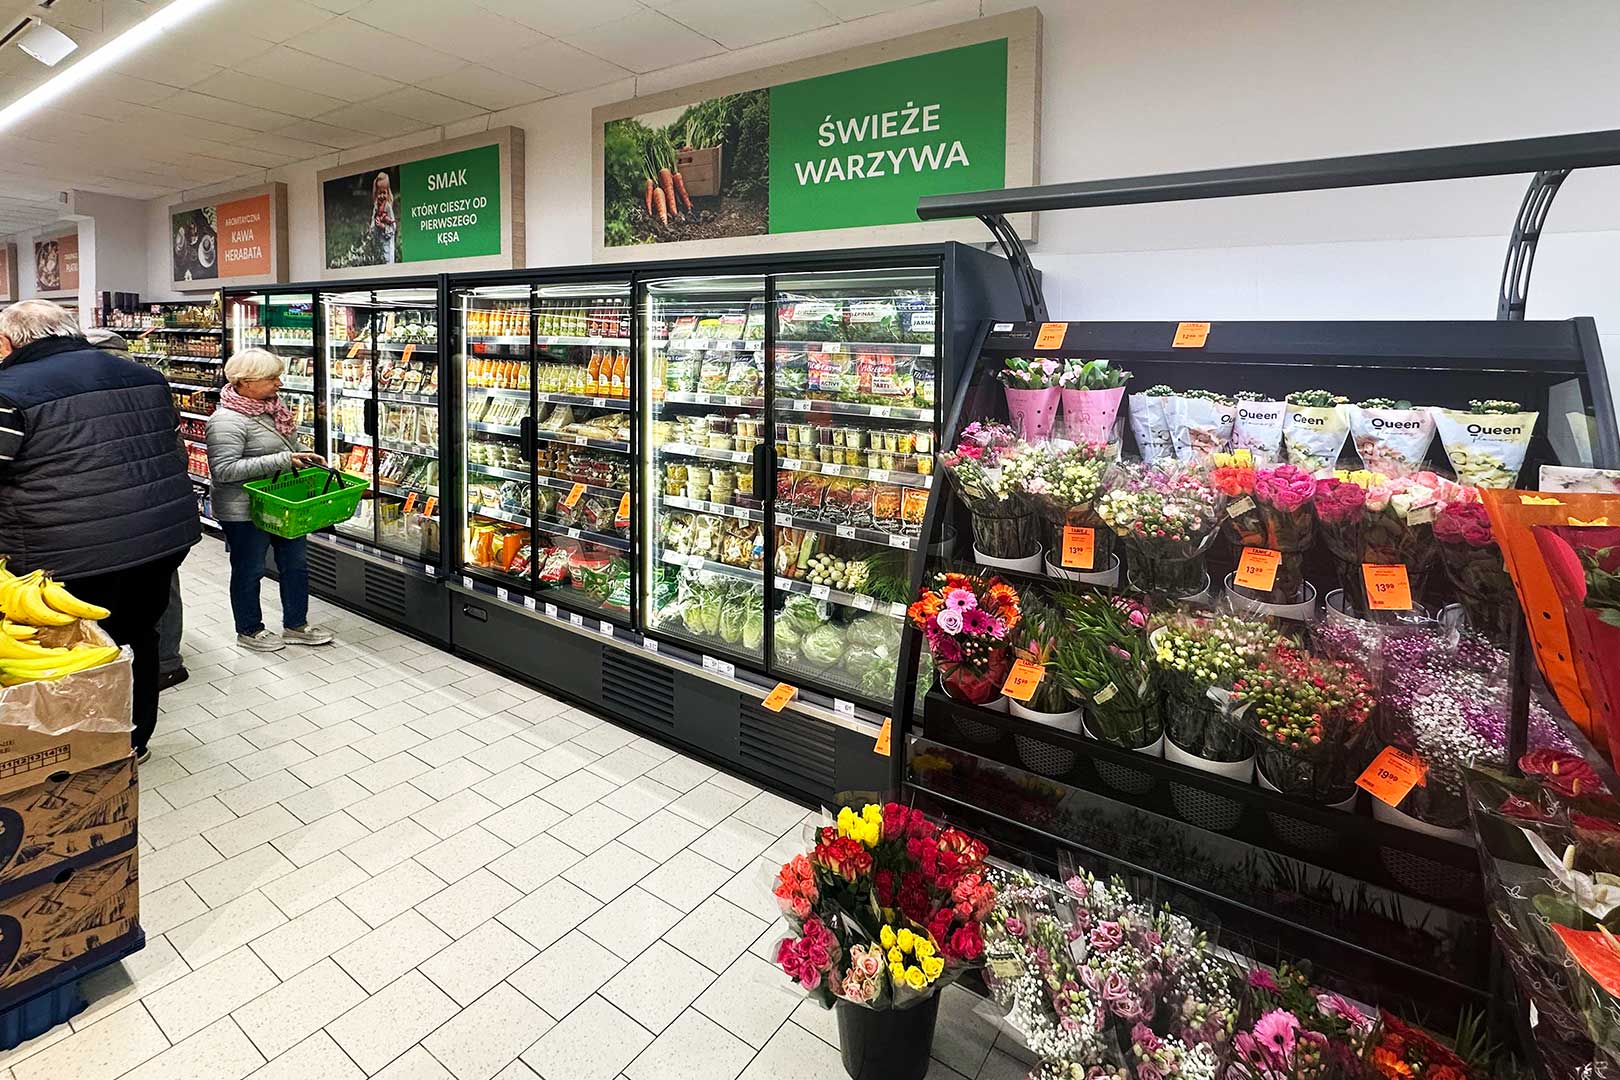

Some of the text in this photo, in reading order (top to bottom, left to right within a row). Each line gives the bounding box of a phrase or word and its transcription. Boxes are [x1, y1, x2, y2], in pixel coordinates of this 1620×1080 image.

[818, 102, 940, 146] ŚWIEŻE
[794, 140, 970, 186] WARZYWA
[427, 168, 468, 191] SMAK
[411, 196, 487, 218] KTÓRY CIESZY OD
[420, 213, 478, 231] PIERWSZEGO
[231, 229, 254, 243] KAWA
[437, 231, 460, 246] KĘSA
[1239, 408, 1277, 420] Queen
[1371, 418, 1420, 430] Queen
[1467, 424, 1521, 436] Queen
